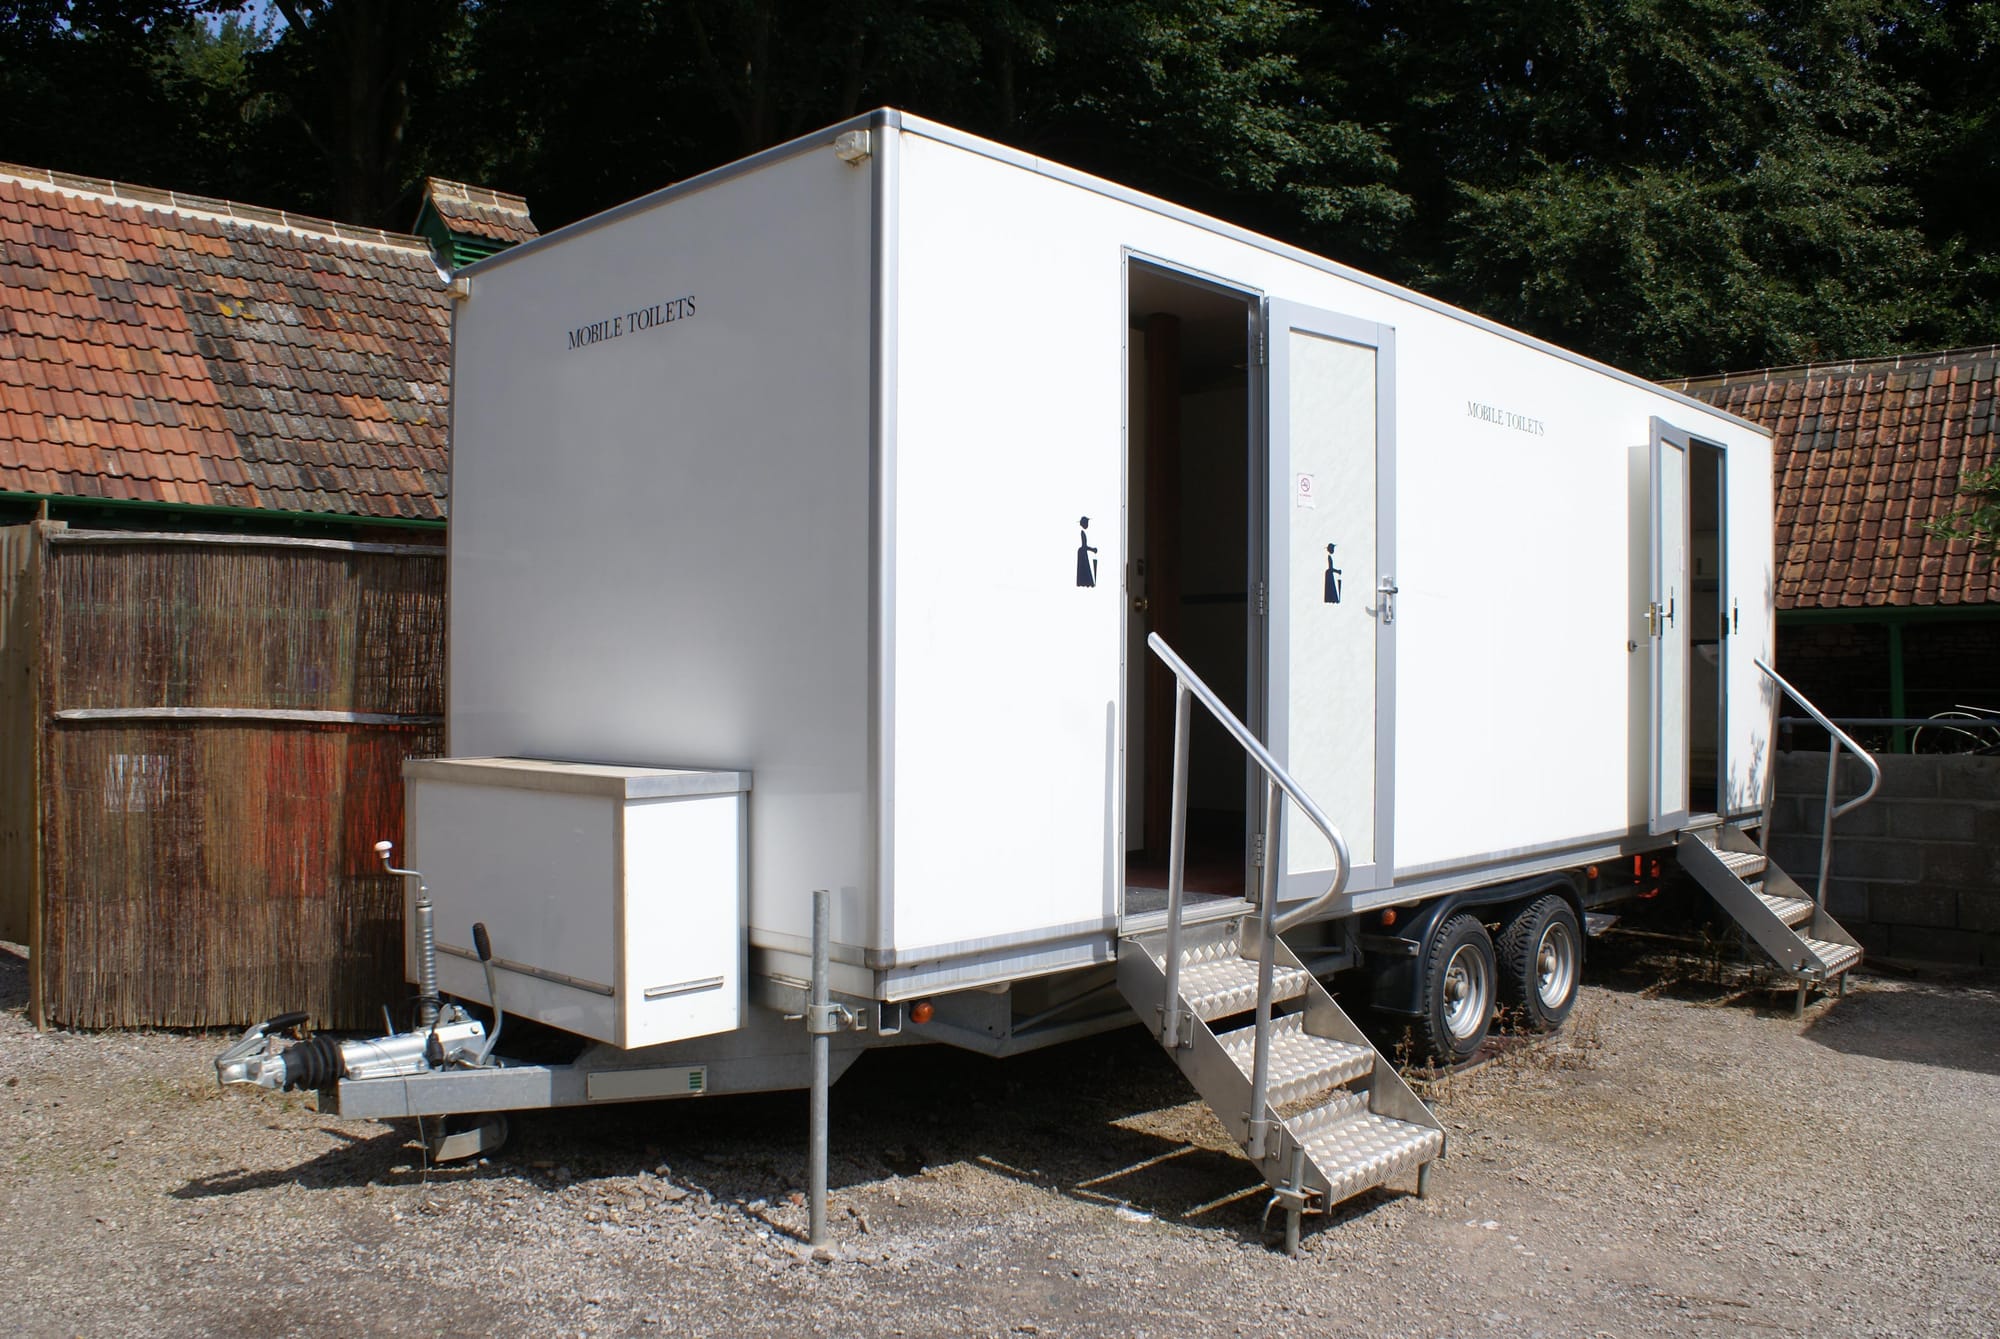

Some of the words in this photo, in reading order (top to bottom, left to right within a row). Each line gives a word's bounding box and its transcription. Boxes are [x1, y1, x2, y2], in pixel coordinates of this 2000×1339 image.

[568, 316, 623, 350] MOBILE
[627, 295, 696, 334] TOILETS
[1467, 400, 1504, 426] MOBILE
[1506, 411, 1545, 437] TOILETS
